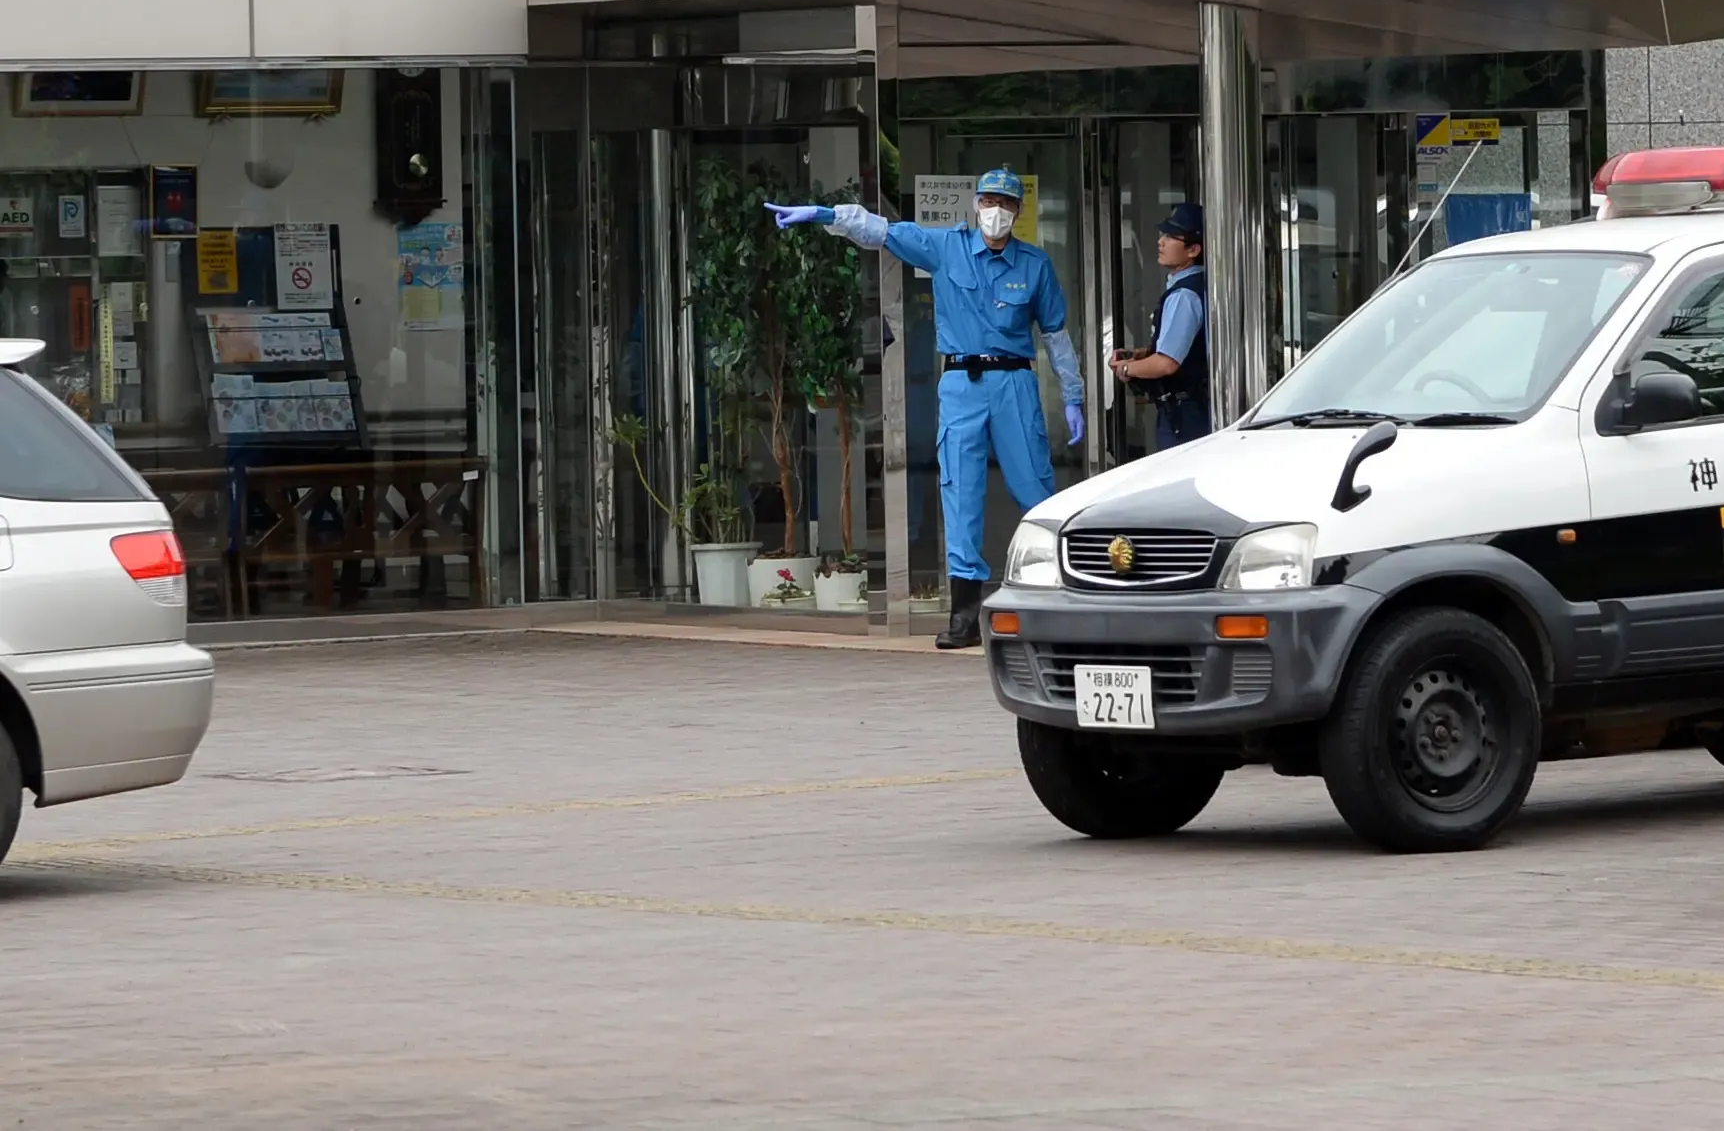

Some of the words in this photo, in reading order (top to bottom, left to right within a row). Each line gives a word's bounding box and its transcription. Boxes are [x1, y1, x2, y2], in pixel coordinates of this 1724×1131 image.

[1417, 146, 1449, 155] ALSOK
[919, 193, 960, 205] スタッフ
[1, 212, 30, 224] AED
